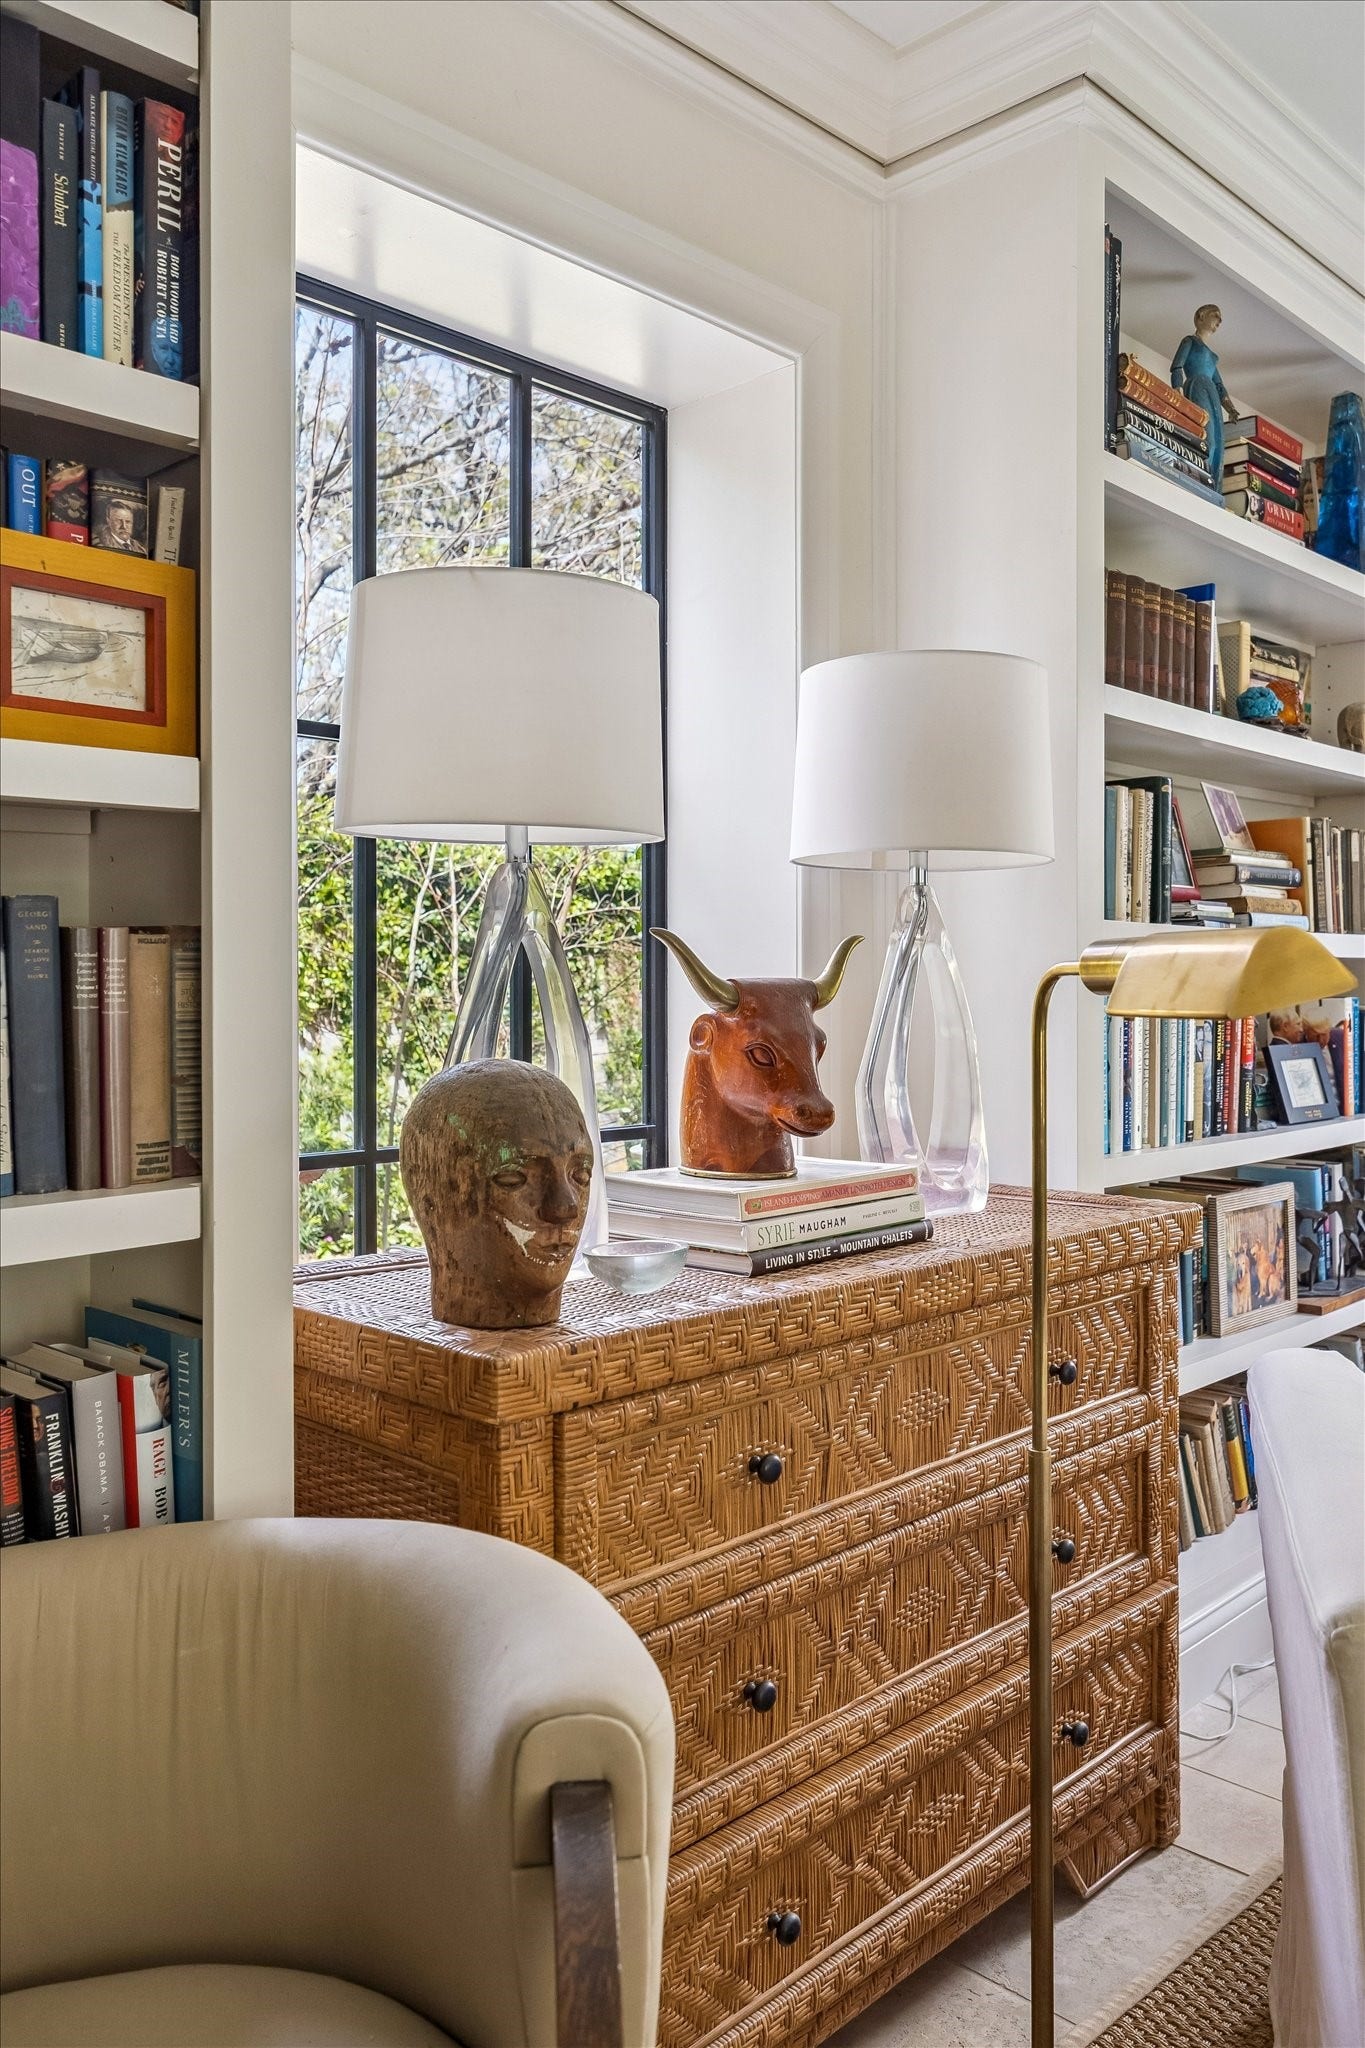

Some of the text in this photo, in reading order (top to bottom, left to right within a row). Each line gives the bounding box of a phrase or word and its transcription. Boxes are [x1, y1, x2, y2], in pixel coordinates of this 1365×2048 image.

[115, 105, 128, 197] BRIAN KILMEADE
[54, 172, 69, 227] Schubert
[157, 137, 182, 232] PERIL
[112, 247, 121, 301] FREEDOM
[122, 256, 130, 318] PRESIDENT
[156, 249, 168, 339] ROBERT COSTA
[170, 254, 180, 344] BOB WOODWARD
[112, 302, 121, 352] FIGHTER
[21, 468, 36, 507] OUT
[1266, 500, 1295, 524] GRANT
[17, 910, 49, 918] GEORG
[757, 1216, 847, 1246] SYRIE MAUGHAM
[764, 1197, 790, 1208] ISLAND
[790, 1192, 821, 1204] HOPPING
[765, 1254, 794, 1269] LIVING
[795, 1251, 805, 1263] IN
[807, 1246, 831, 1260] STYLE
[840, 1237, 880, 1254] MOUNTAIN
[881, 1230, 914, 1246] CHALETS
[177, 1349, 191, 1449] MILLER'S
[0, 1406, 20, 1506] SAVING FREEDOM
[45, 1412, 65, 1482] FRANKLIN
[94, 1400, 108, 1494] BARACK OBAMA
[152, 1437, 168, 1519] RAGE BOB
